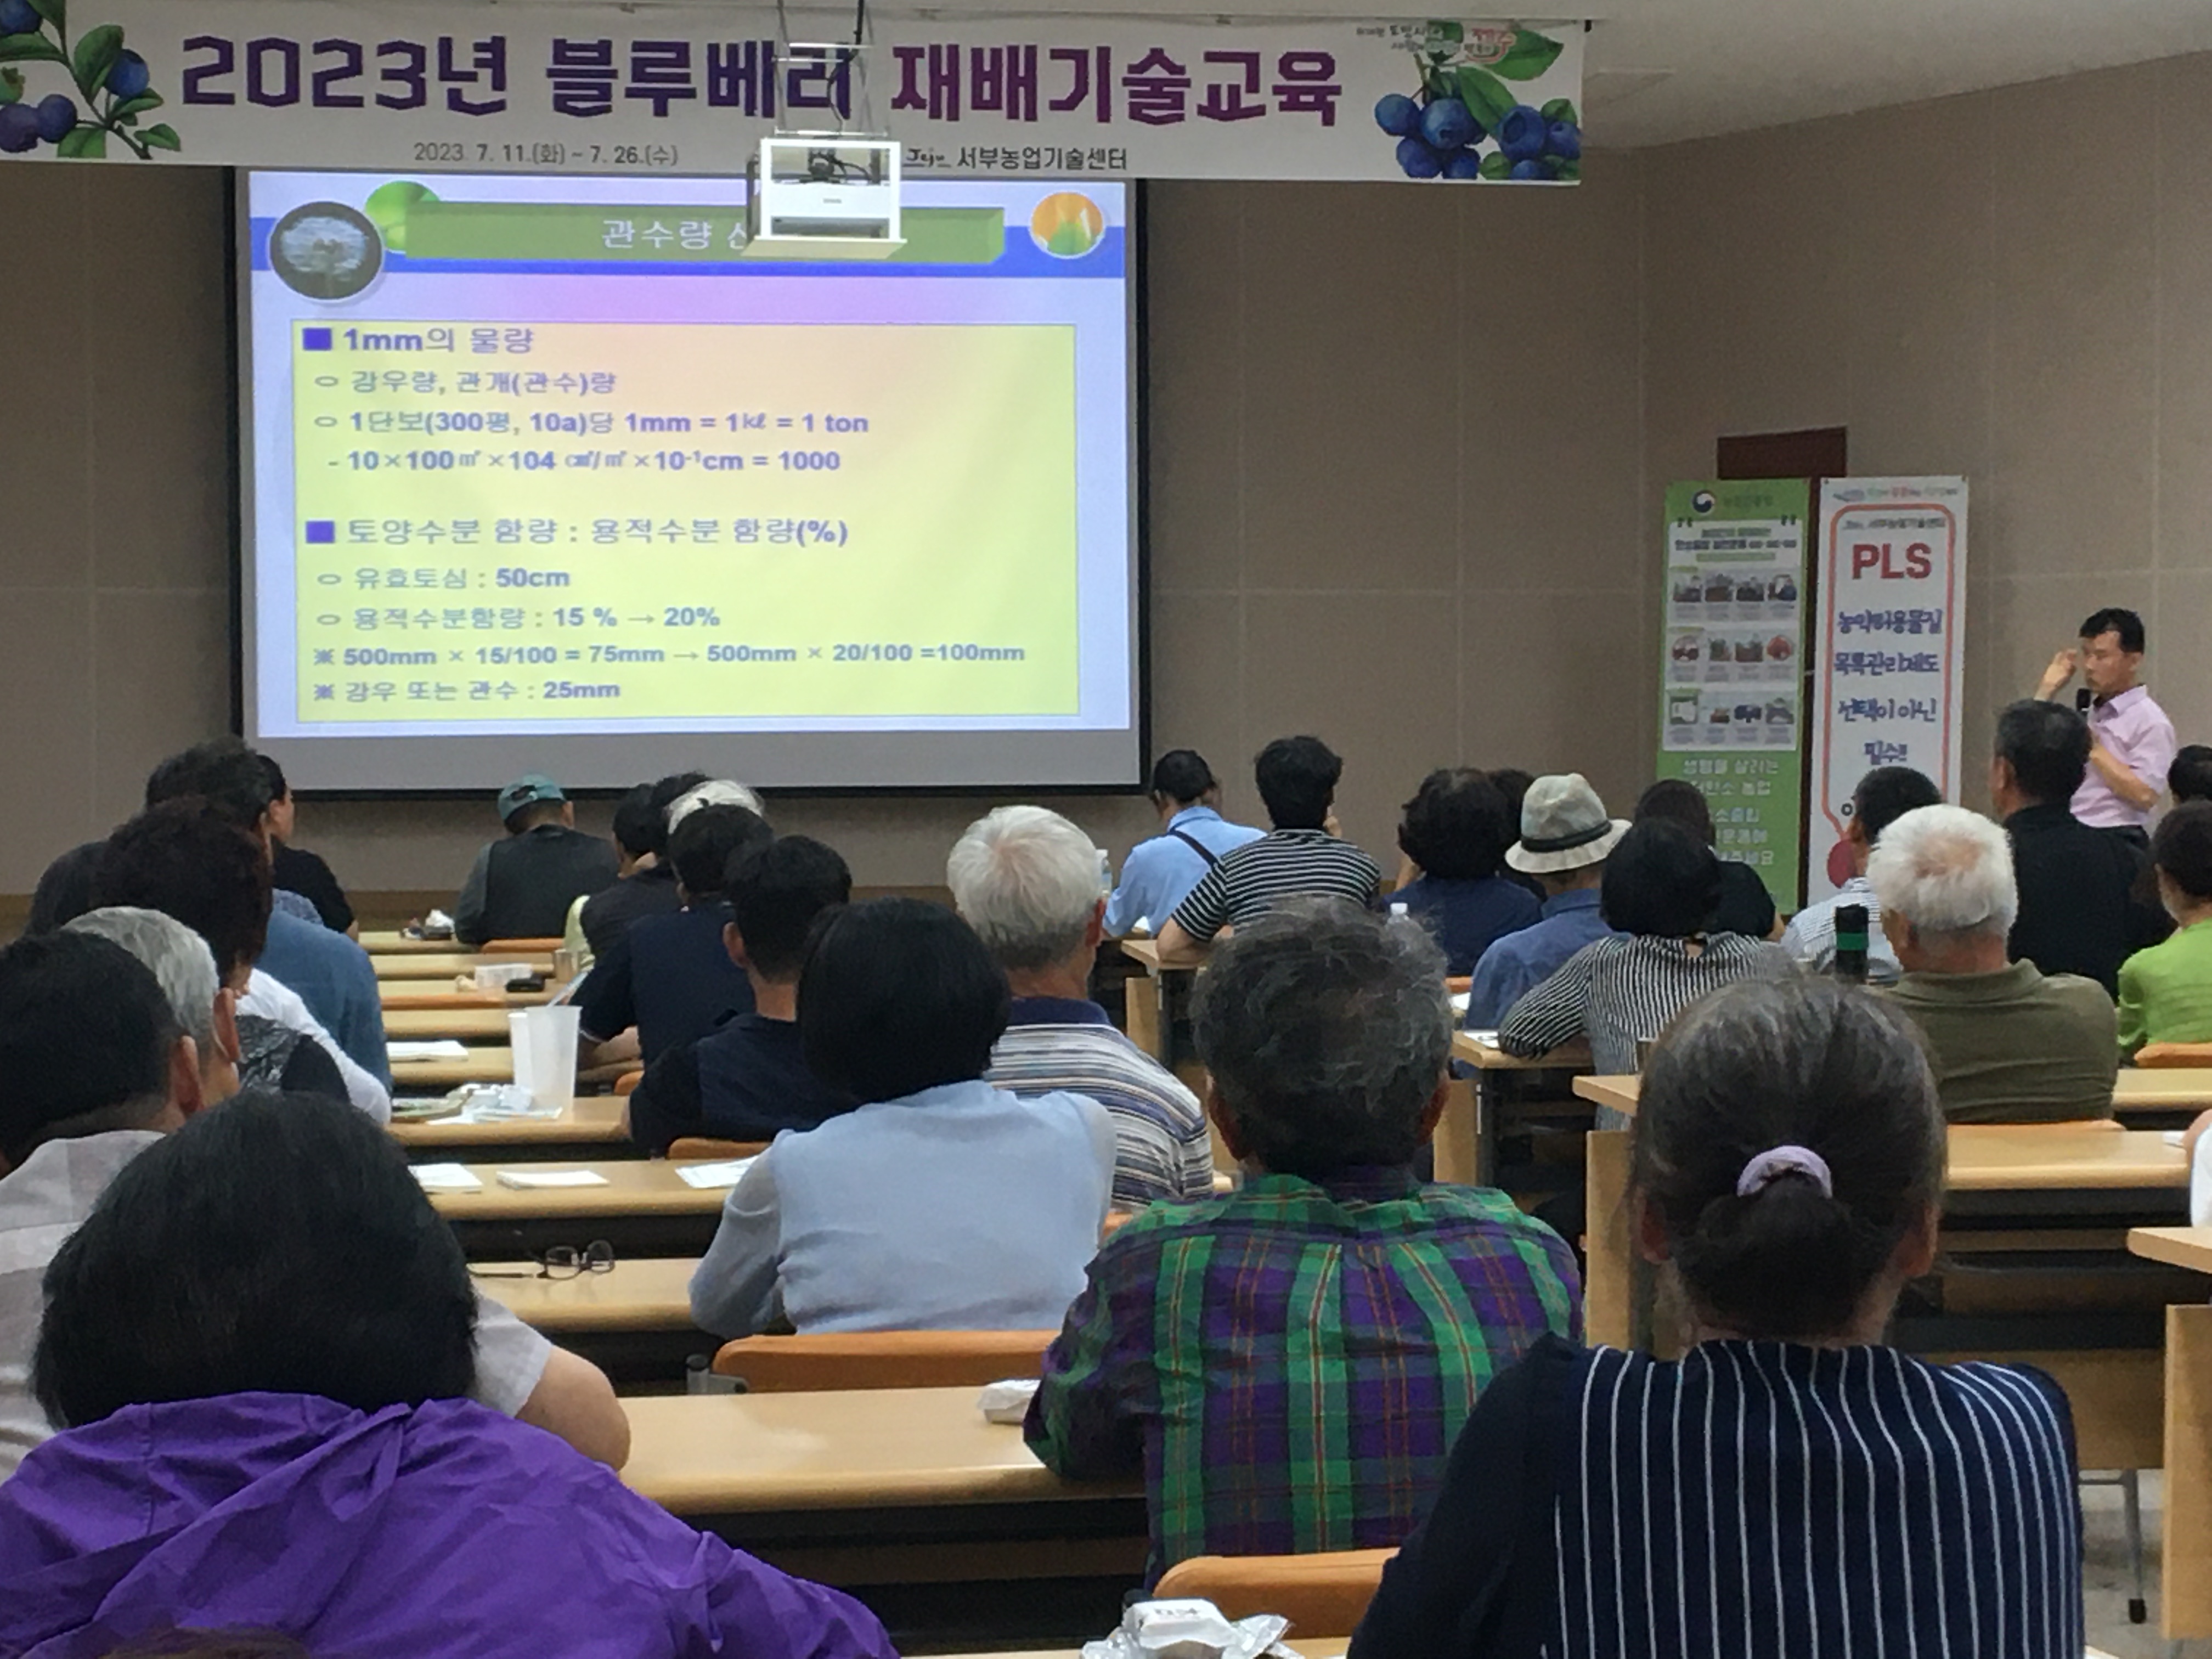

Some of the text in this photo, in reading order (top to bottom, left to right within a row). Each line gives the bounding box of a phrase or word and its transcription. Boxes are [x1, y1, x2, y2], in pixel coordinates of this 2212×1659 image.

[182, 35, 1342, 127] 2023년 블루베리 재배기술교육
[413, 142, 469, 162] 2023.
[613, 145, 679, 166] 26.(수)
[957, 146, 1127, 170] 서부농업기술센터
[602, 219, 713, 250] 관수량
[343, 328, 534, 354] 1mm의 물량
[351, 370, 447, 396] 강우량,
[530, 410, 614, 436] 10a)당
[624, 413, 691, 433] 1mm
[824, 414, 870, 433] ton
[777, 450, 841, 471] 1000
[347, 518, 481, 545] 토양수분
[494, 518, 558, 545] 함량
[591, 518, 721, 545] 용적수분
[733, 517, 849, 548] 함량(%)
[1852, 542, 1932, 580] PLS
[354, 567, 468, 590] 유효토심
[495, 567, 571, 589] 50cm
[353, 607, 526, 630] 용적수분함량
[663, 607, 721, 627] 20%
[1837, 609, 1943, 634] 농약허용물질
[343, 647, 438, 667] 500mm
[475, 646, 558, 665] 15/100
[588, 645, 665, 663] 75mm
[706, 645, 797, 662] 500mm
[832, 644, 913, 662] 20/100
[1834, 651, 1940, 676] 목록관리제도
[345, 680, 397, 703] 강우
[407, 680, 459, 701] 또는
[469, 680, 520, 702] 관수
[542, 681, 622, 699] 25mm
